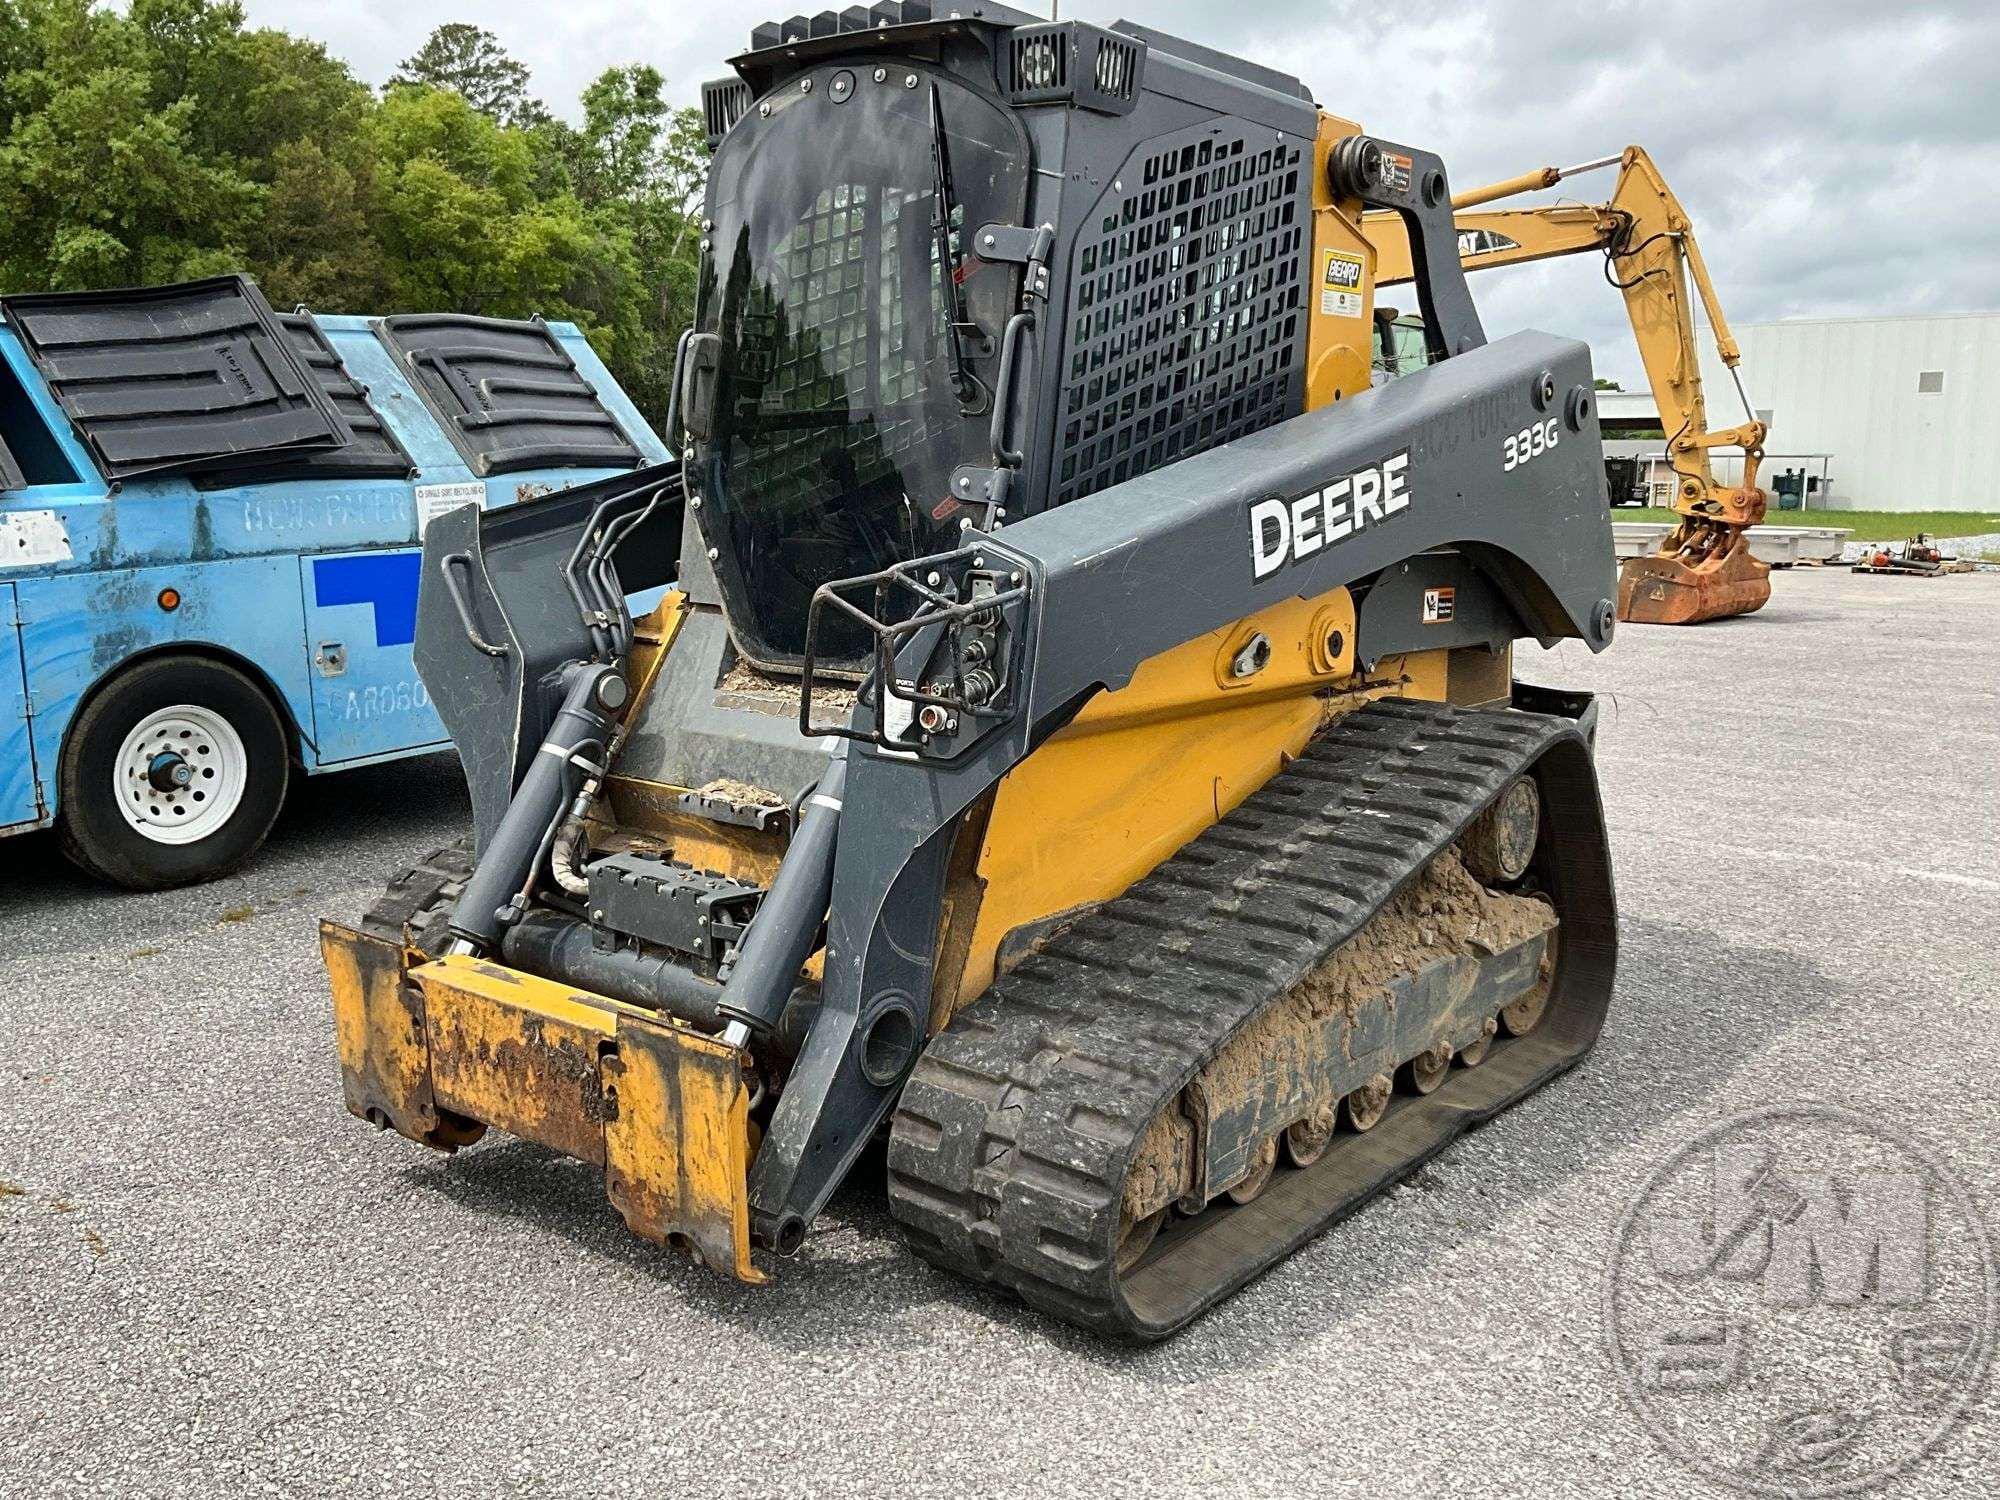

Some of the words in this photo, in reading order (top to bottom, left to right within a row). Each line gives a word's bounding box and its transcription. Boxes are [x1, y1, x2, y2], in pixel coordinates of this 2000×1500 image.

[1457, 231, 1480, 255] AT
[1329, 260, 1359, 287] BEARD
[1503, 417, 1558, 472] 333G
[1250, 453, 1409, 578] DEERE
